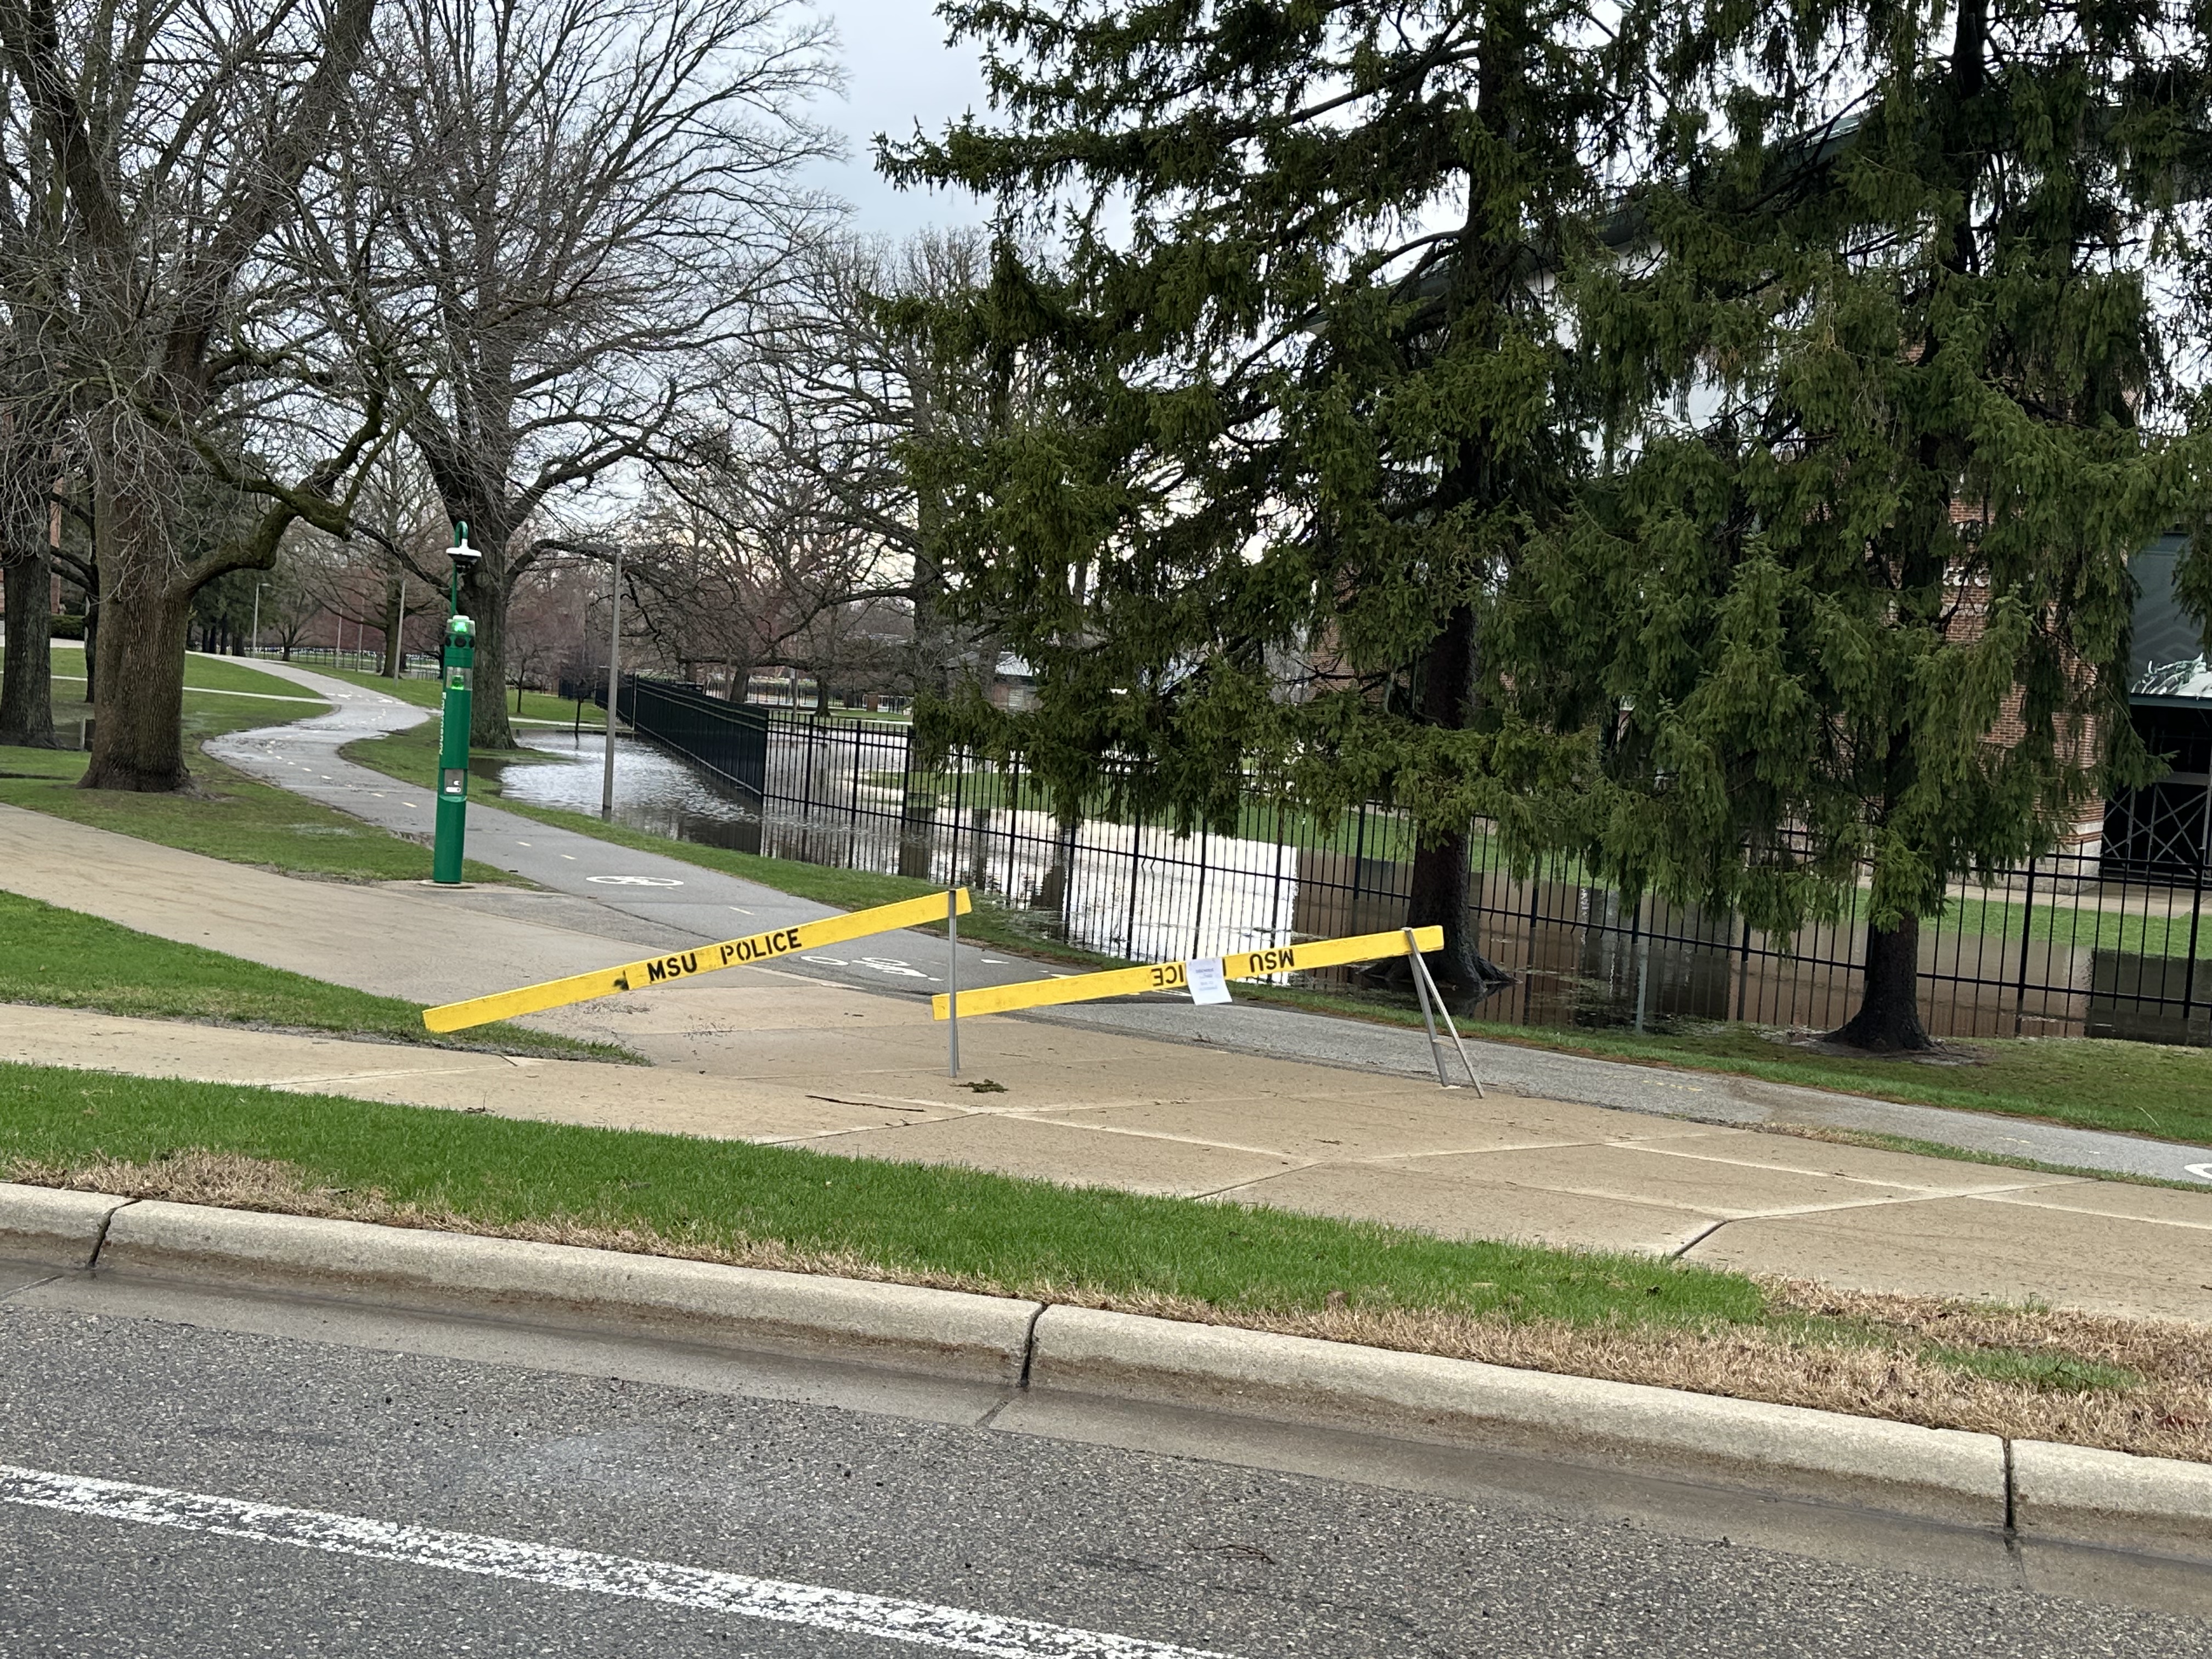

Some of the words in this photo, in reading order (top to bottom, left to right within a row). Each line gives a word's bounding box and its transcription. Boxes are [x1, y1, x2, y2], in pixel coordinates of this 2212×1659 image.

[647, 952, 697, 982] MSU
[720, 928, 802, 965] POLICE
[1249, 949, 1295, 973] MSU
